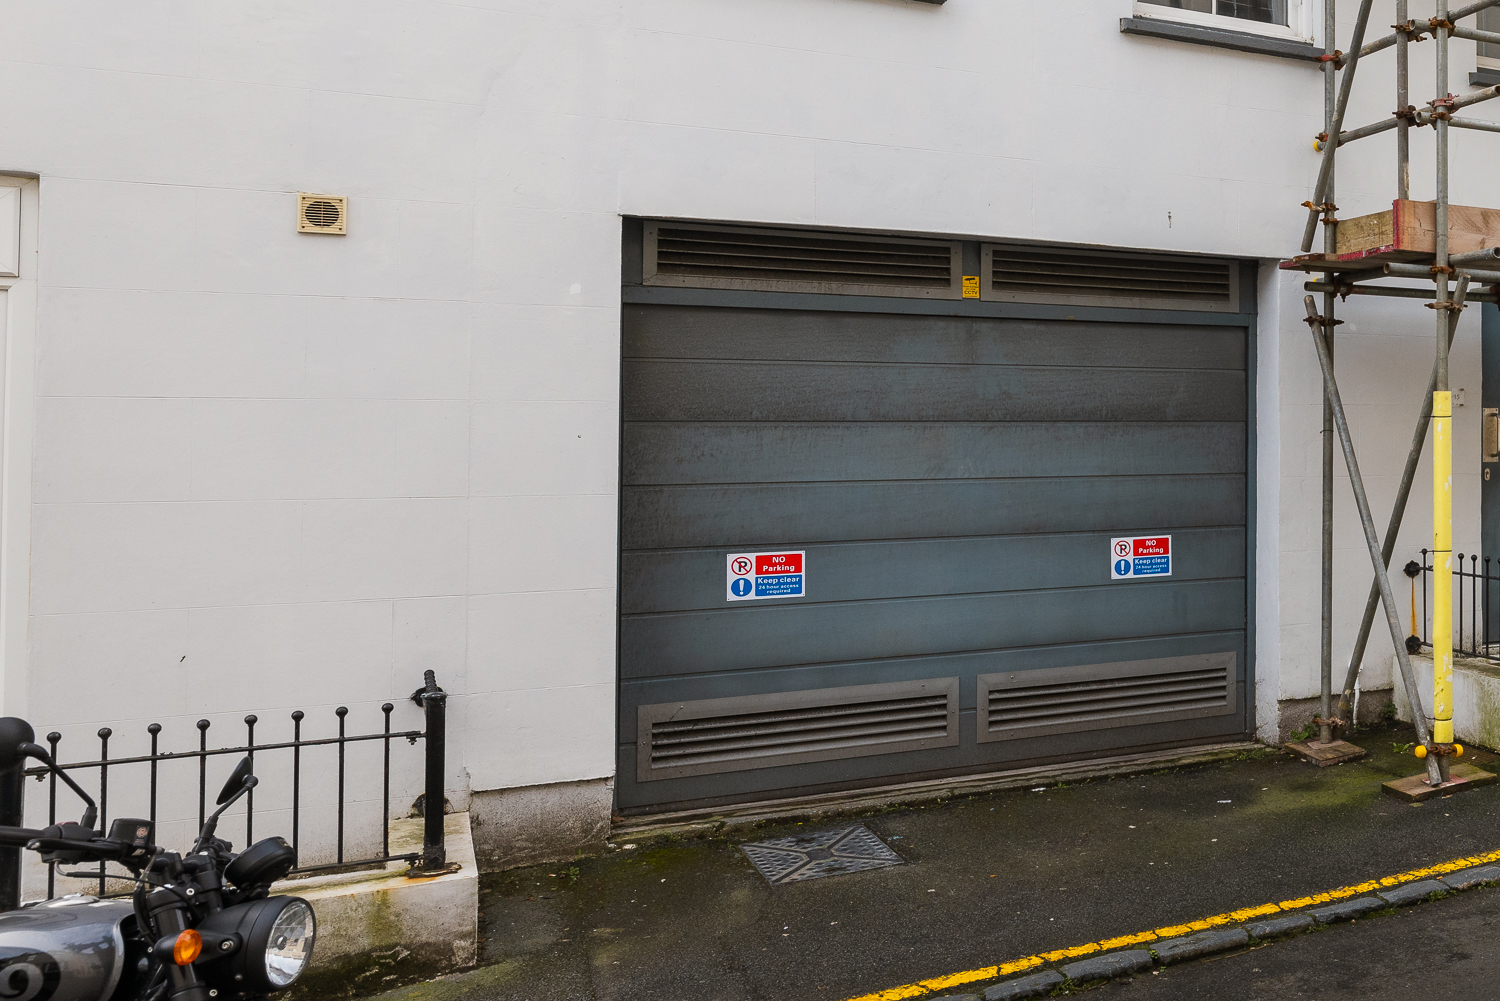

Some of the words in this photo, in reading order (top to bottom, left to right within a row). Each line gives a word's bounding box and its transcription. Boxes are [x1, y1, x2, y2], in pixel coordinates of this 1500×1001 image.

[1145, 539, 1157, 547] NO
[1138, 547, 1164, 555] Parking
[762, 564, 795, 573] Parking
[757, 577, 779, 585] Keep
